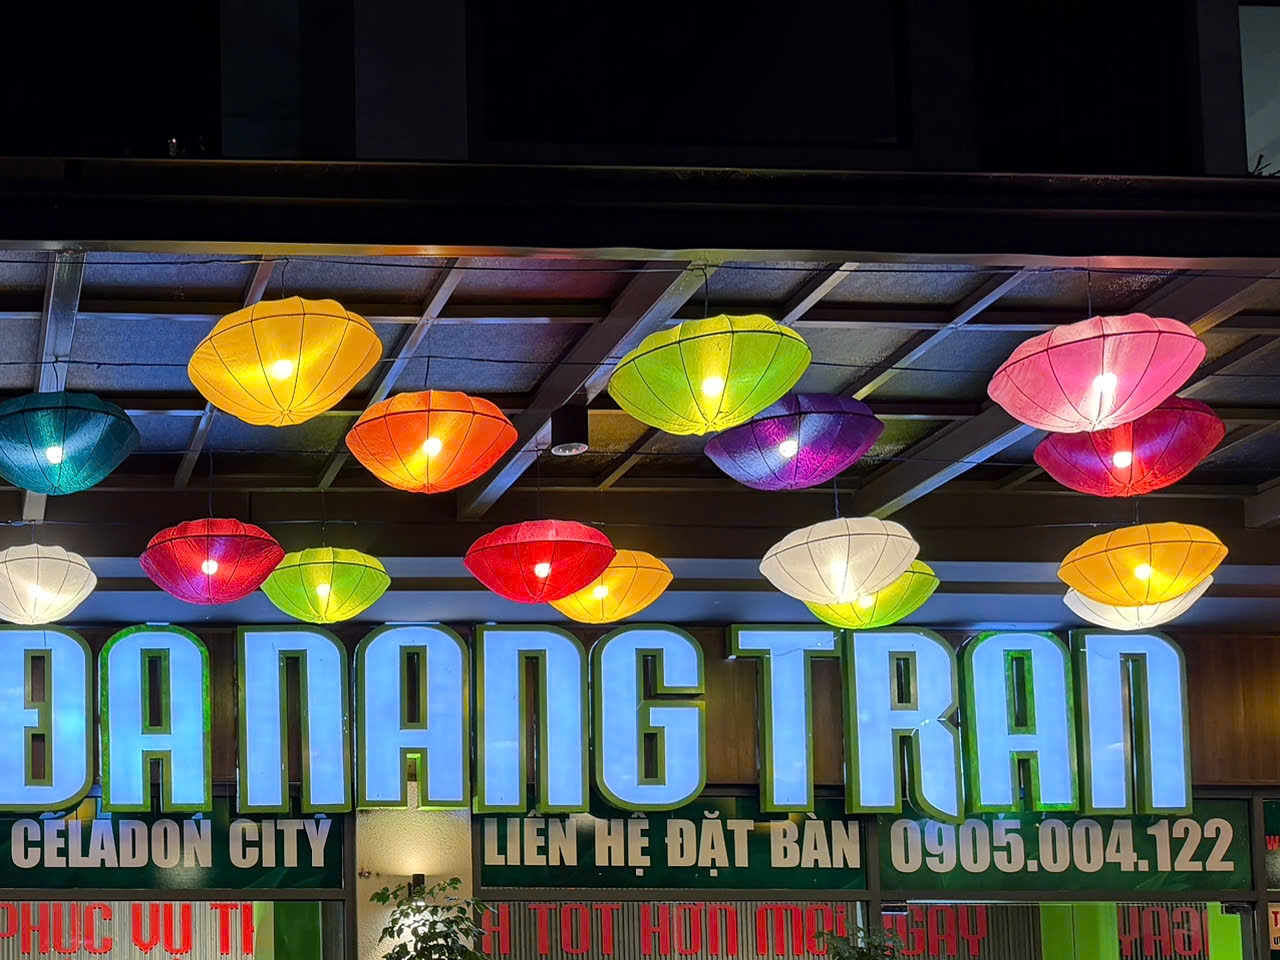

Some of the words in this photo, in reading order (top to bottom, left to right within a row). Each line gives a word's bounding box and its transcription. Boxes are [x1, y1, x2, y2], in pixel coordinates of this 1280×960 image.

[11, 818, 212, 869] CELADON
[229, 818, 332, 869] CITY
[484, 809, 577, 867] LIÊN
[595, 811, 651, 876] HỆ
[665, 810, 754, 877] ĐẶT
[770, 811, 860, 869] BÀN
[890, 817, 1235, 873] 0905.004.122
